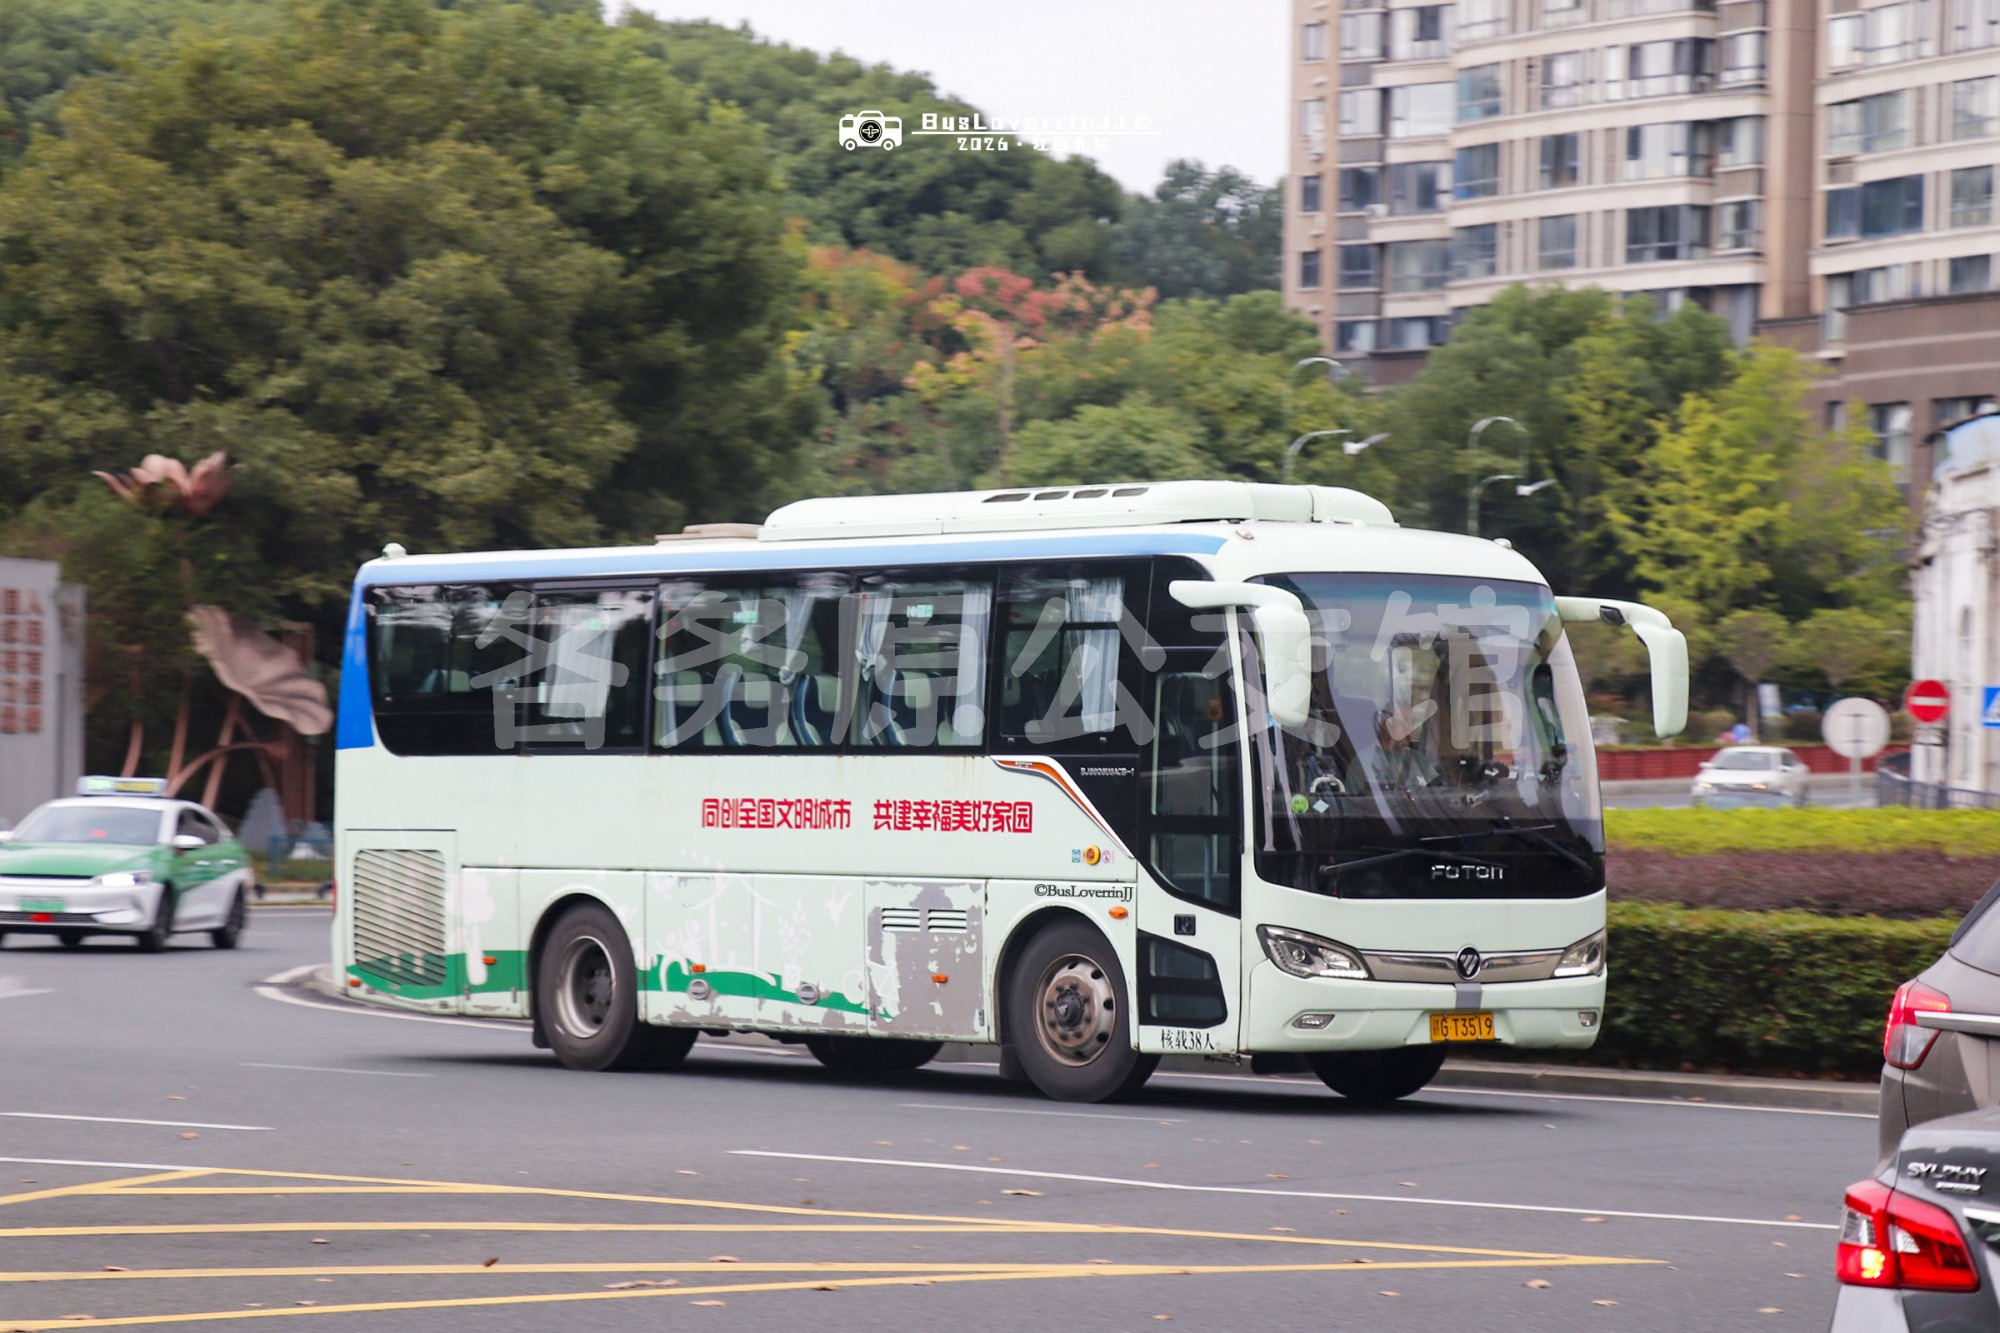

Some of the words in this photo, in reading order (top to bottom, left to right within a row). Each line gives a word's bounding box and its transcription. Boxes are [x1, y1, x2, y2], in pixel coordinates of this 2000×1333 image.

[702, 797, 851, 830] 同创全国文明城市
[872, 799, 1033, 834] 共建幸福美好家园
[1431, 864, 1503, 880] FOTON
[1161, 1028, 1214, 1051] 核载38人
[1907, 1162, 1987, 1182] SYLPHY
